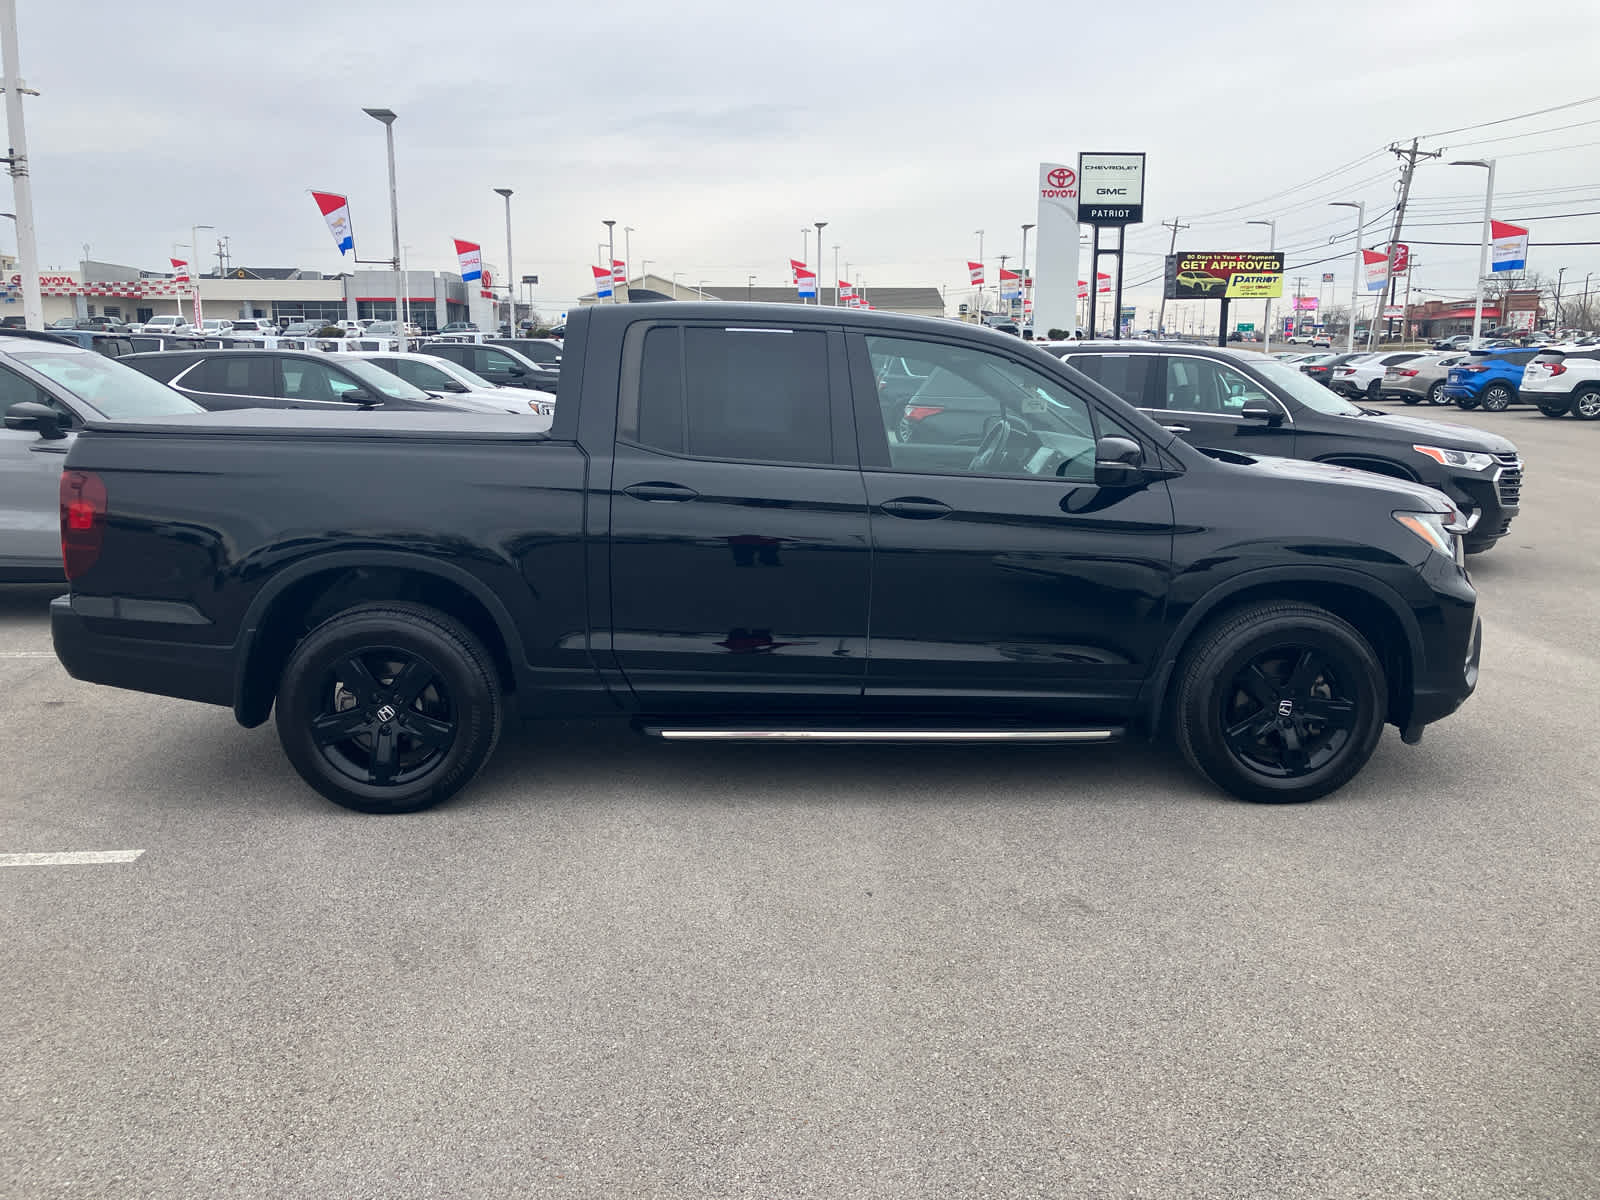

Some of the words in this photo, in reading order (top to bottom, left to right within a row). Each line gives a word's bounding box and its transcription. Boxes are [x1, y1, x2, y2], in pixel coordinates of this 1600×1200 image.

[1091, 209, 1130, 217] PATRIOT
[1181, 260, 1207, 270] GET
[1210, 260, 1280, 270] APPROVED
[39, 276, 73, 285] OYOTA
